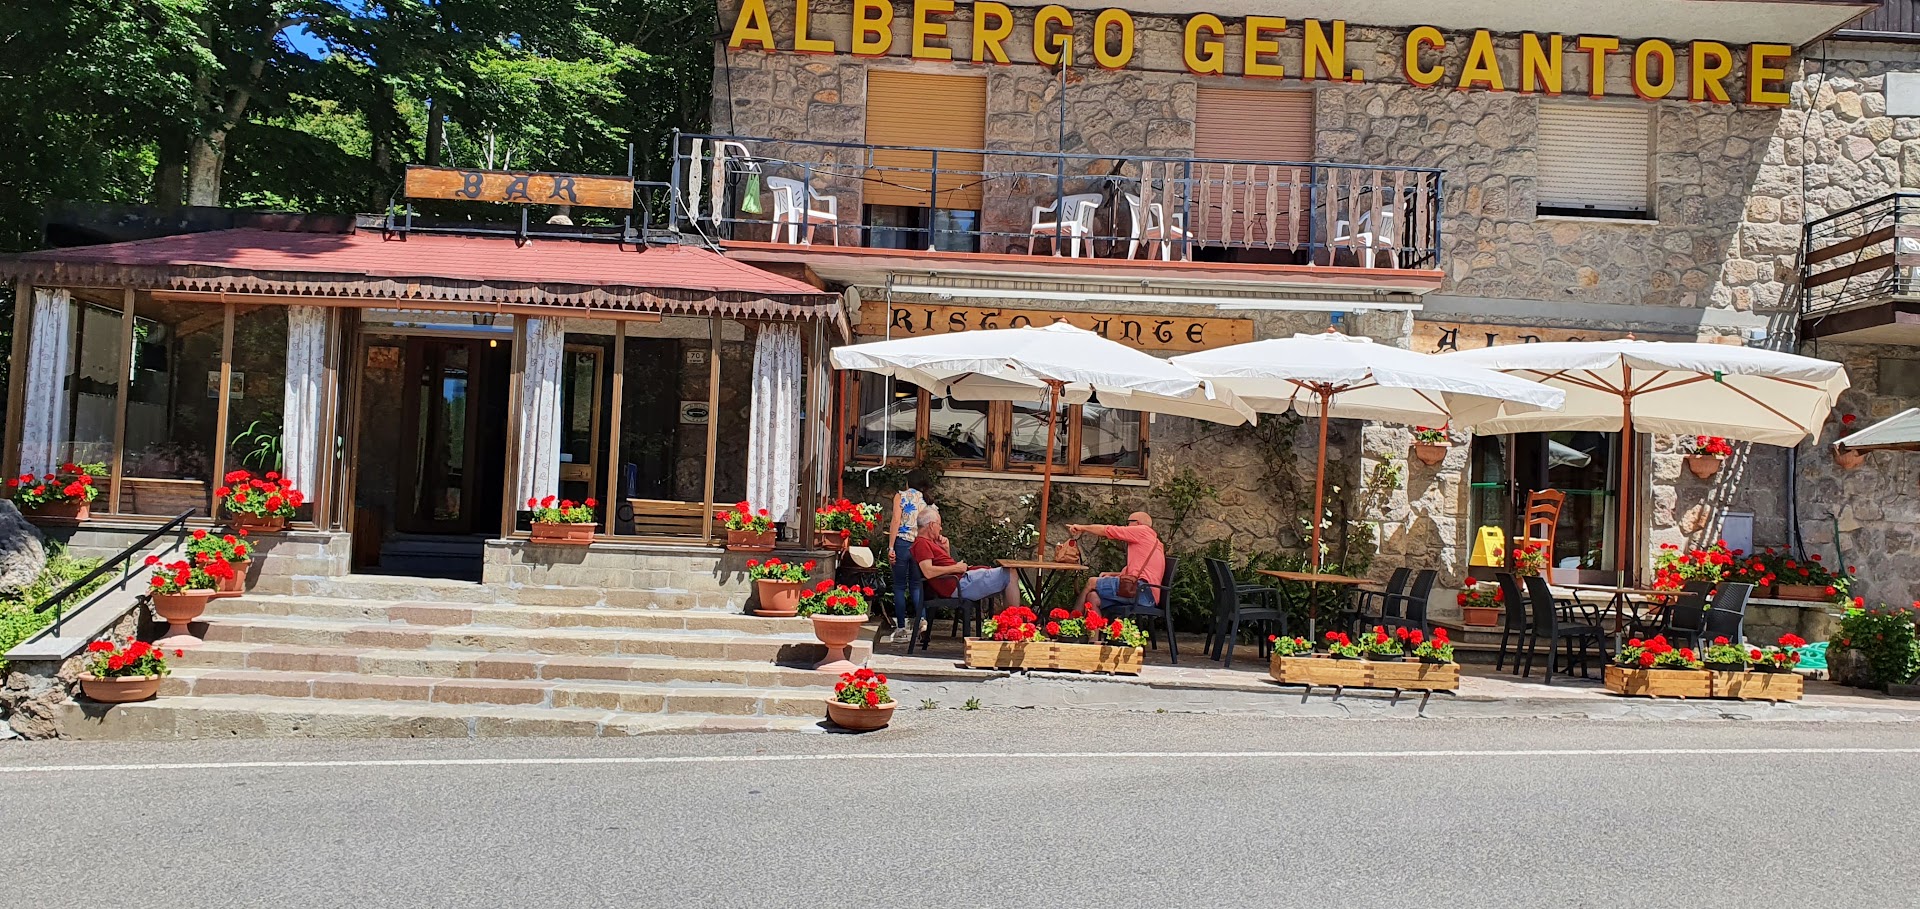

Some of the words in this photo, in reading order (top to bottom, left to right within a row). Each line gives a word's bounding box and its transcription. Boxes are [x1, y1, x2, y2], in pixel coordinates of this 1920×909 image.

[727, 0, 1135, 70] ALBERGO
[1183, 13, 1364, 82] GEN.
[1403, 26, 1793, 104] CANTORE
[455, 170, 580, 204] BAR
[889, 307, 1208, 345] RISTOANTE
